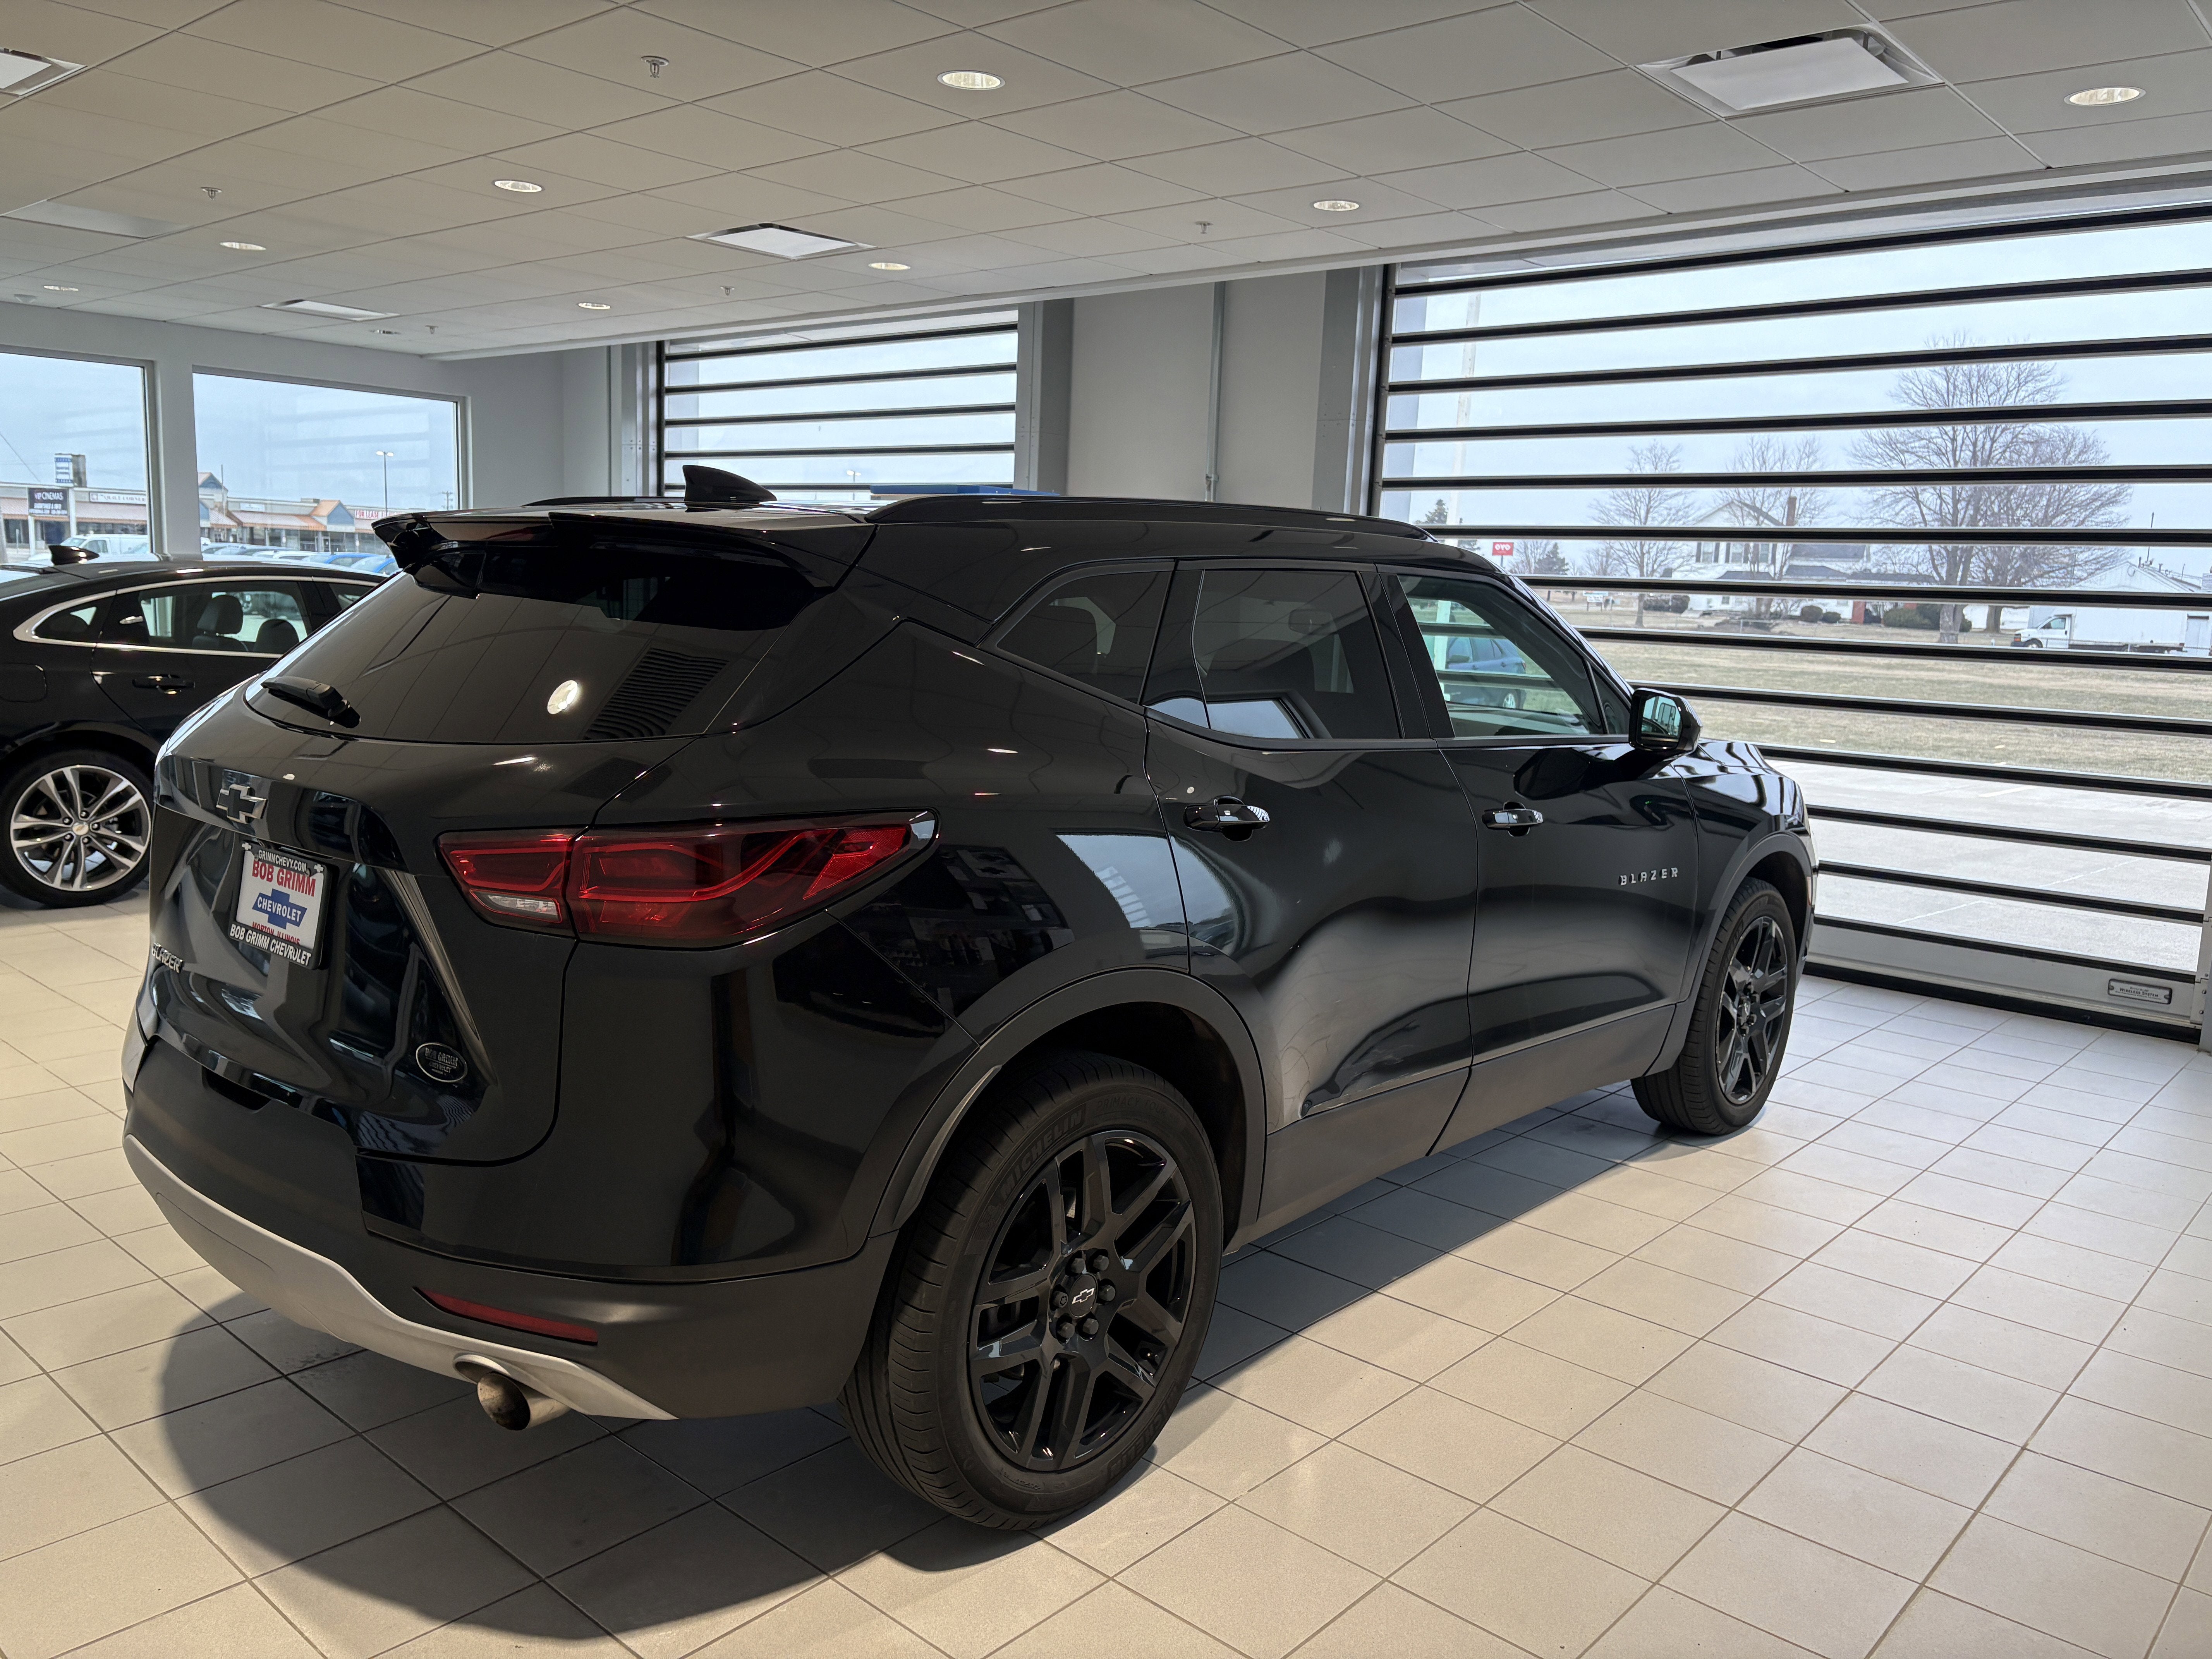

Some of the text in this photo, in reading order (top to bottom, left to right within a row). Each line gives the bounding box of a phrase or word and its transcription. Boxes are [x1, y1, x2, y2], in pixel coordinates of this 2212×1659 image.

[258, 850, 306, 872] GRIMMCHEVY.COM
[252, 861, 316, 897] BOB GRIMM
[1620, 867, 1678, 886] BLAZER
[257, 896, 301, 922] CHEVROLET
[152, 943, 183, 973] BLAZER
[230, 924, 311, 966] BOB GRIMM CHEVROLET
[1000, 1109, 1082, 1201] MICHELIN
